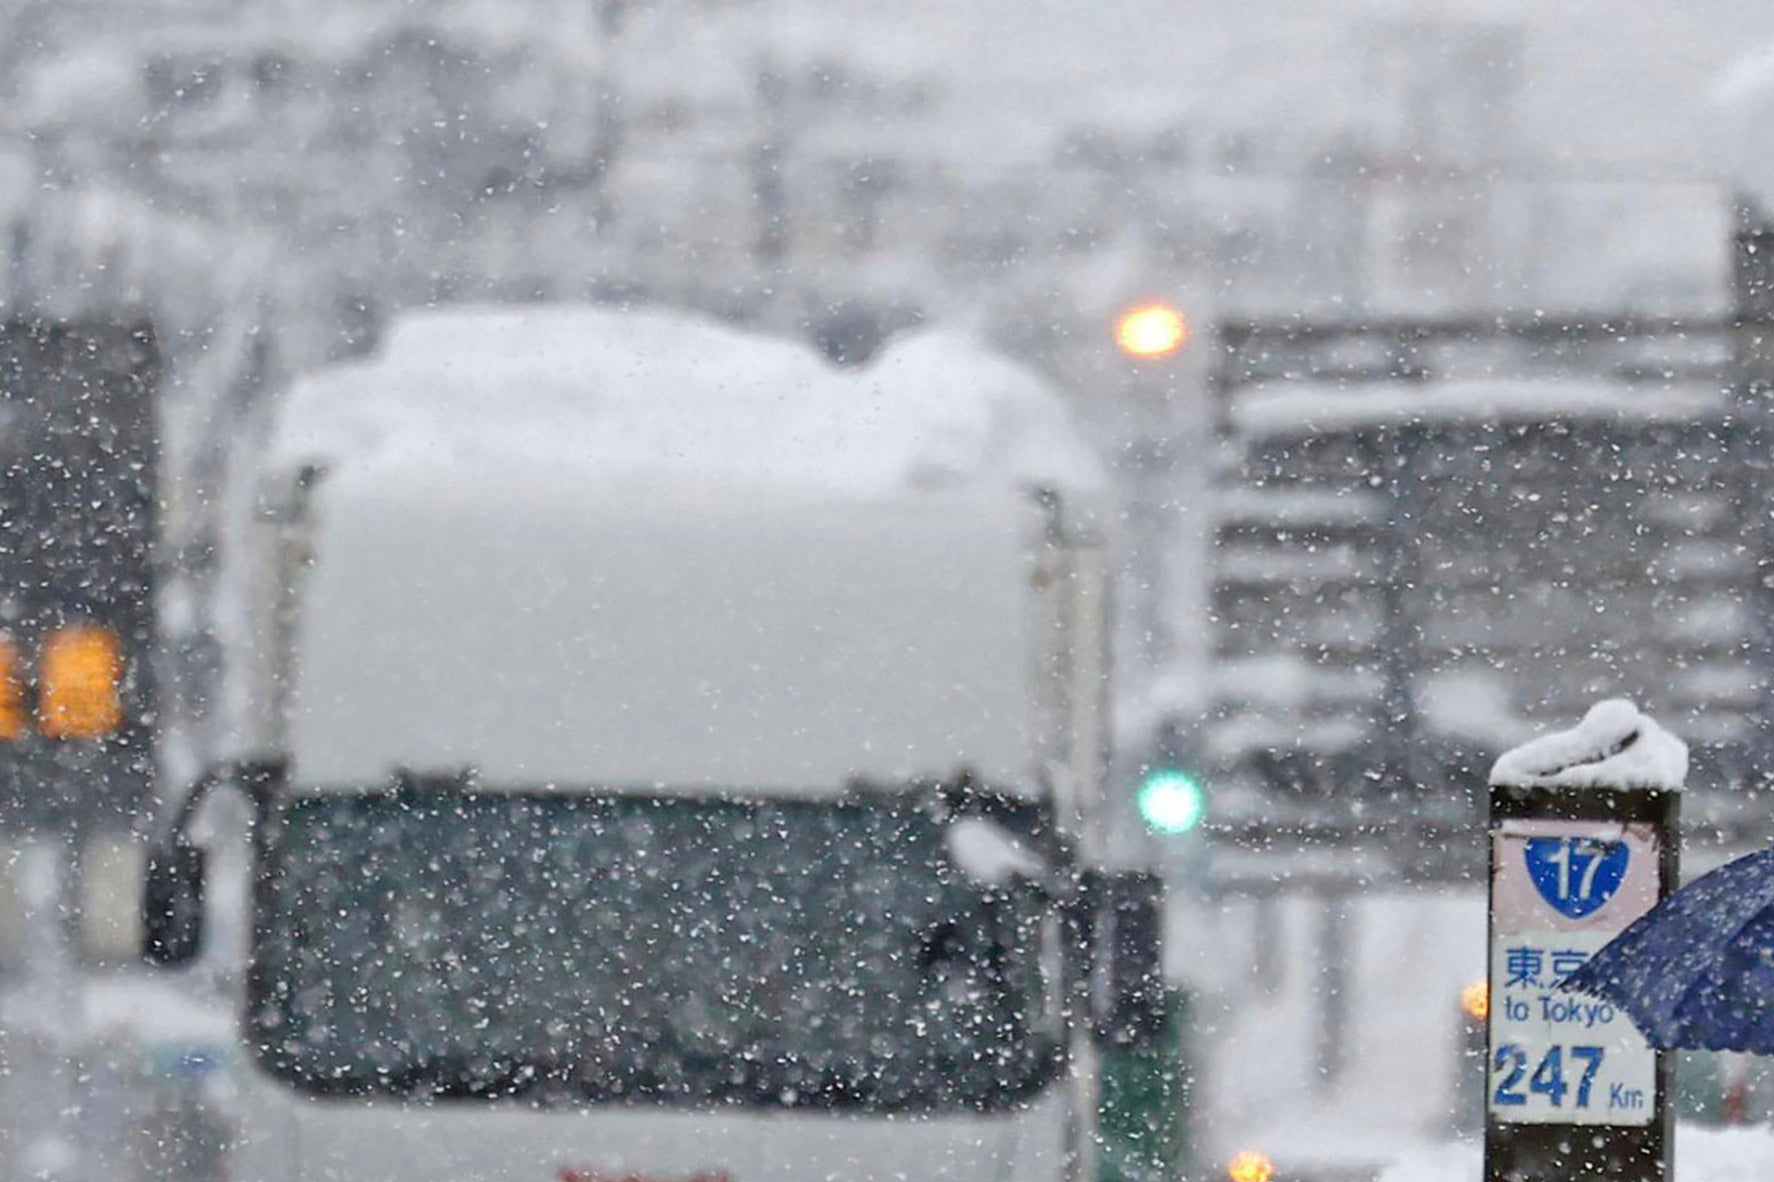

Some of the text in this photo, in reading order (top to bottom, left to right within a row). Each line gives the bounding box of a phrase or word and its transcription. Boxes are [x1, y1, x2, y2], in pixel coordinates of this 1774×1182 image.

[1547, 845, 1605, 900] 17
[1504, 995, 1614, 1028] to Tokyo
[1493, 1043, 1604, 1108] 247
